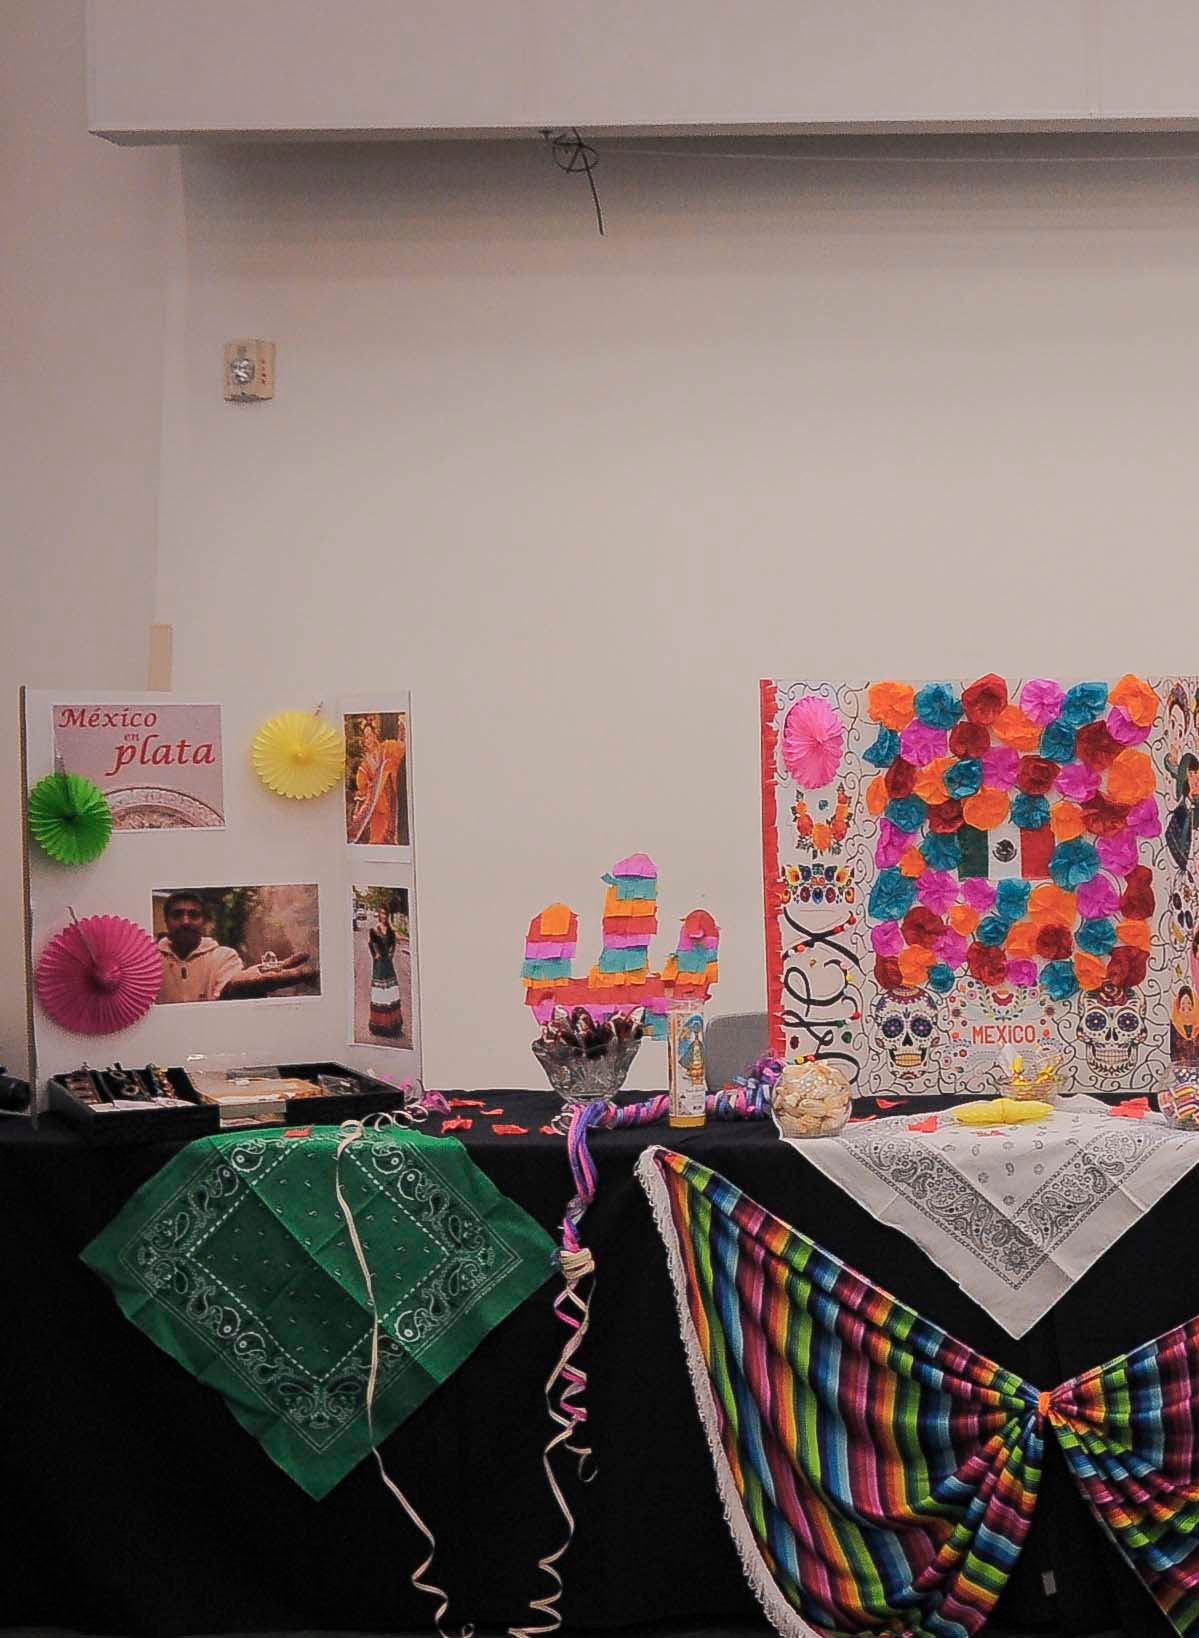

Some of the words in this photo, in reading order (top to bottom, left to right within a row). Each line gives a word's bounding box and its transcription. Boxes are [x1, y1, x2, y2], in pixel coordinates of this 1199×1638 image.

[58, 707, 157, 728] México
[123, 732, 140, 742] en
[104, 734, 216, 777] plata
